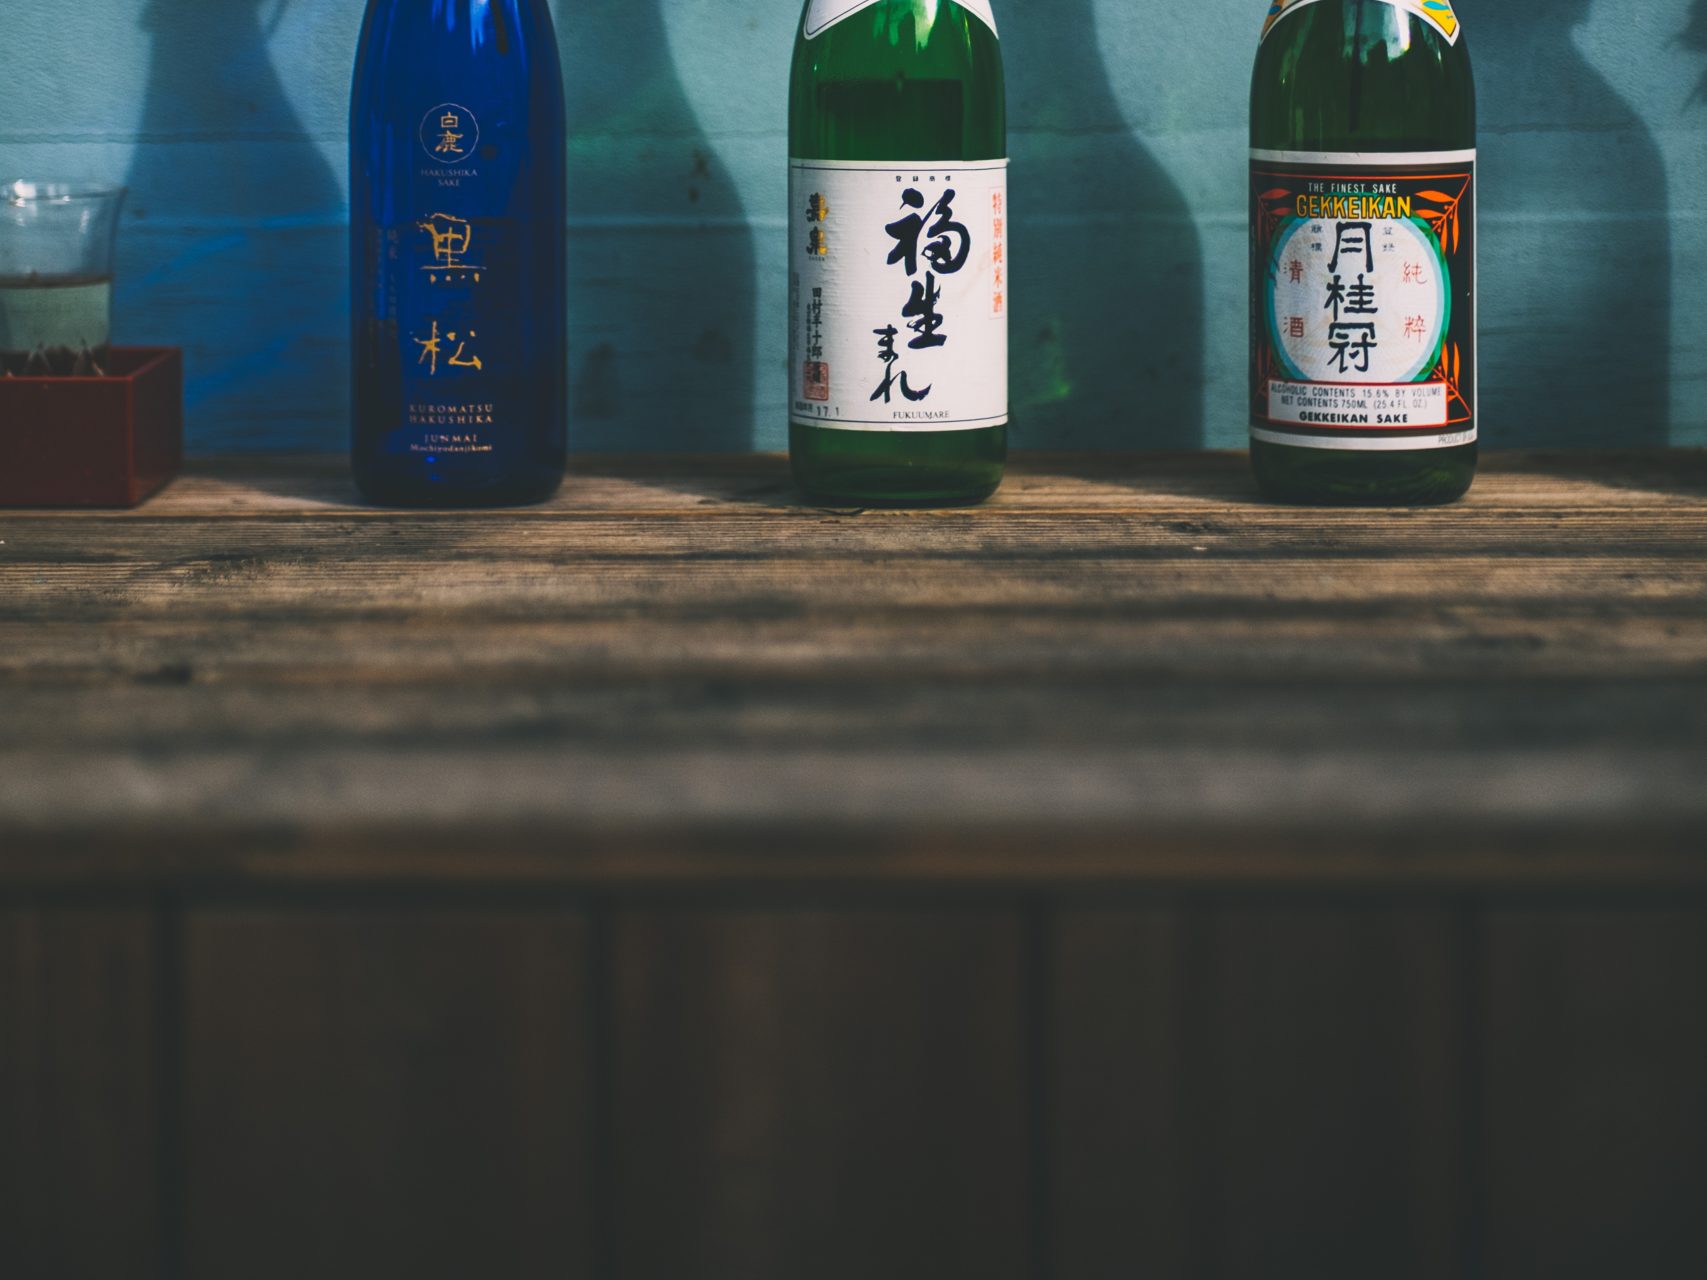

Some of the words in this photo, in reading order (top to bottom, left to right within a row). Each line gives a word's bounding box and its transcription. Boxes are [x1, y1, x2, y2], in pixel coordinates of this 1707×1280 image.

[1308, 182, 1324, 193] THE
[1331, 183, 1365, 194] FINEST
[1372, 183, 1397, 194] SAKE
[1296, 194, 1412, 219] GEKKEIKAN
[1323, 221, 1379, 375] 月桂冠
[1270, 382, 1308, 396] ALCOHOLIC
[1312, 387, 1356, 398] CONTENTS
[1362, 388, 1389, 398] 15.6%
[1395, 388, 1406, 398] BY
[1412, 386, 1441, 397] VOLUME
[1281, 395, 1294, 406] NET
[1297, 396, 1339, 409] CONTENTS
[1341, 398, 1368, 410] 750ML
[409, 404, 493, 414] KUROMATSU
[892, 410, 950, 420] FUKUUMARE
[409, 415, 493, 425] HAKUSHIKA
[1299, 411, 1369, 424] GEKKEIKAN
[1376, 413, 1408, 424] SAKE
[424, 434, 478, 443] JUNMAI
